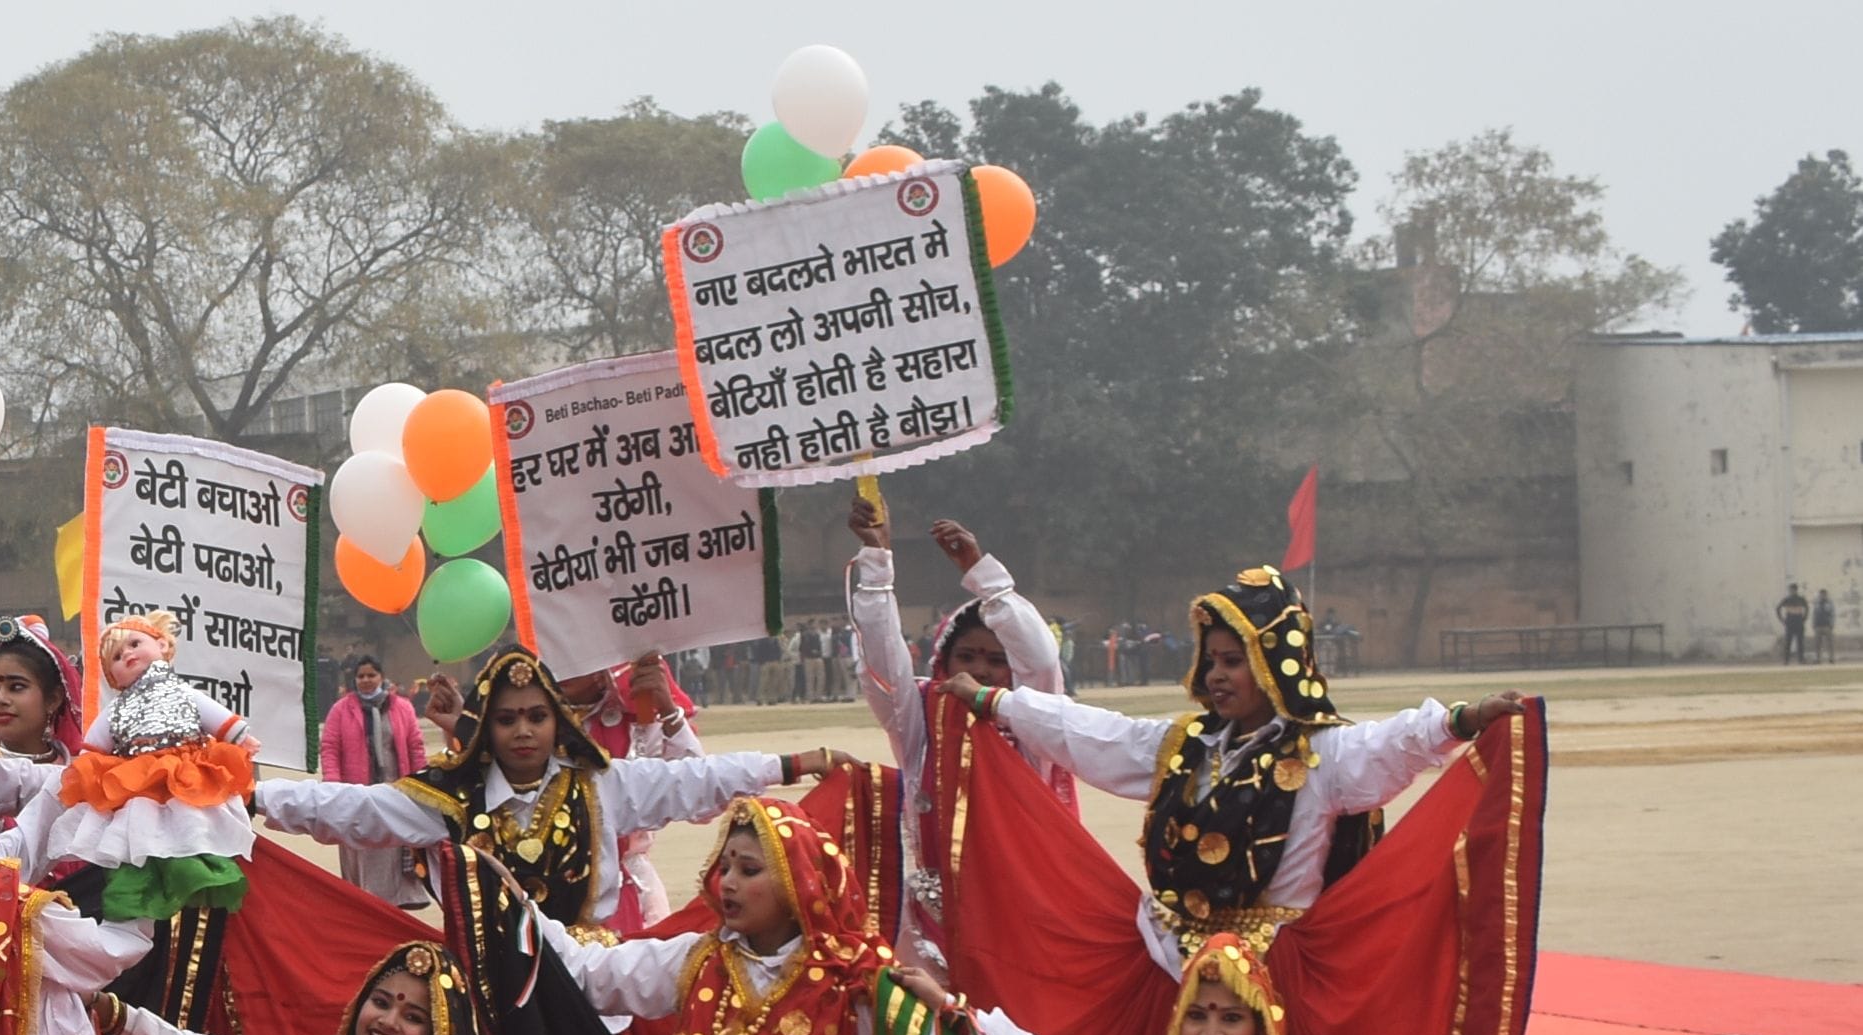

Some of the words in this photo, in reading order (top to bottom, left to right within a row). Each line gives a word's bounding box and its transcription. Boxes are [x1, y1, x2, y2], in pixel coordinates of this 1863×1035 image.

[693, 274, 737, 306] नए
[744, 244, 835, 296] बदलते
[843, 236, 916, 276] भारत
[921, 220, 948, 258] मे
[693, 326, 762, 364] बदल
[767, 308, 805, 352] लो
[814, 288, 894, 341] अपनी
[900, 279, 970, 323] सोच,
[546, 404, 568, 422] Beti
[626, 388, 651, 405] Beti
[708, 367, 787, 418] बेटियाँ
[793, 353, 856, 405] होती
[862, 346, 886, 391] है
[893, 339, 976, 382] सहारा
[510, 454, 542, 492] हर
[546, 443, 580, 477] घर
[584, 425, 609, 467] में
[616, 428, 660, 465] अब
[735, 425, 791, 470] नही
[798, 412, 861, 463] होती
[868, 396, 890, 448] है
[135, 458, 188, 508] बेटी
[196, 479, 280, 526] बचाओ
[592, 471, 671, 522] उठेगी,
[130, 523, 185, 573] बेटी
[531, 536, 598, 592] बेटीयां
[604, 531, 636, 574] भी
[642, 534, 690, 567] जब
[698, 510, 755, 560] आगे
[204, 609, 304, 661] साक्षरता
